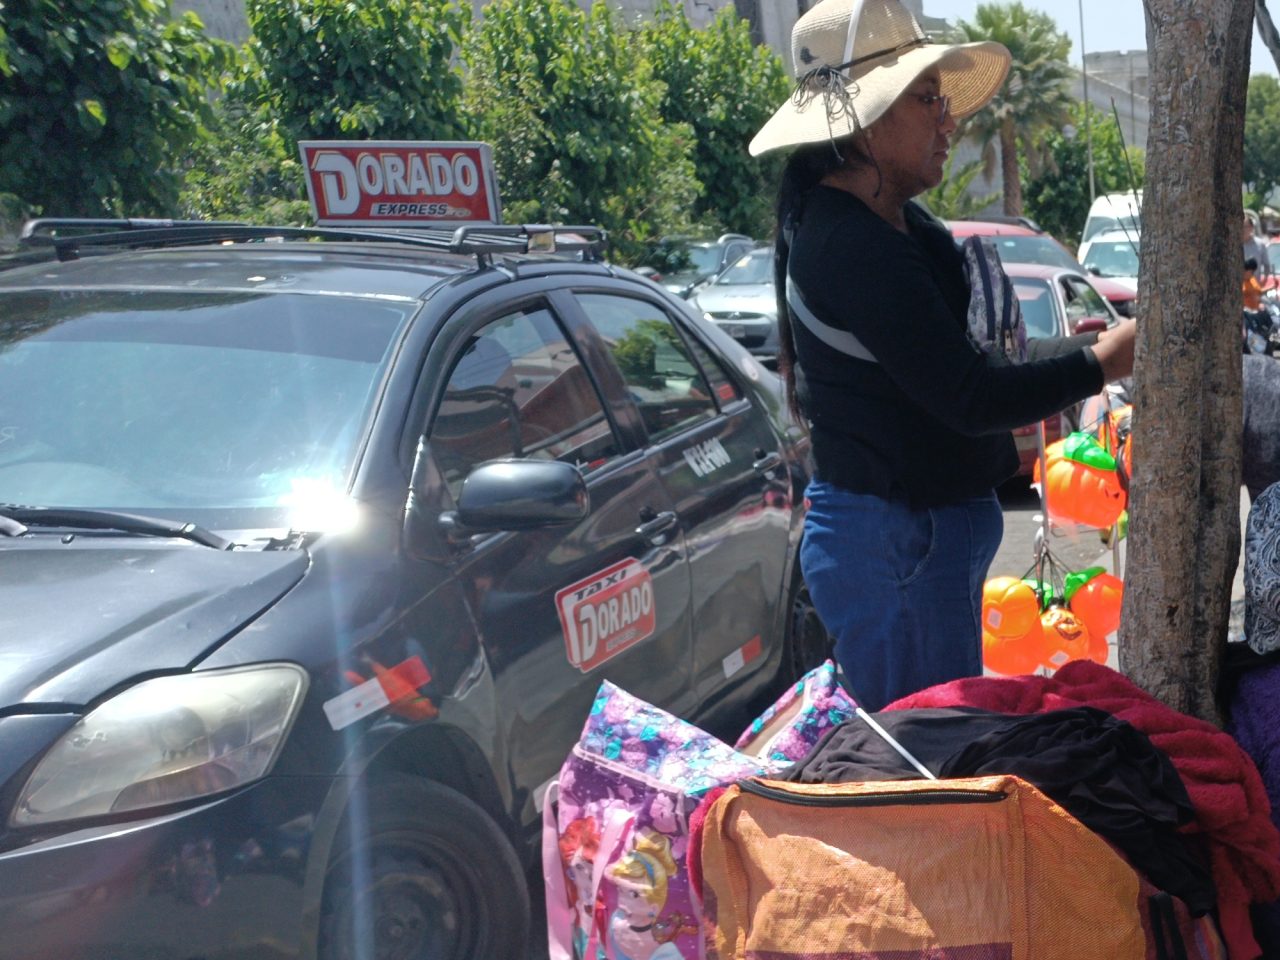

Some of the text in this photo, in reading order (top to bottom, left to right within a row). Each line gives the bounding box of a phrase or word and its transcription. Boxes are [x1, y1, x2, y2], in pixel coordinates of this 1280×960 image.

[311, 151, 479, 215] DORADO
[378, 203, 448, 215] EXPRESS
[580, 580, 651, 662] DORADO
